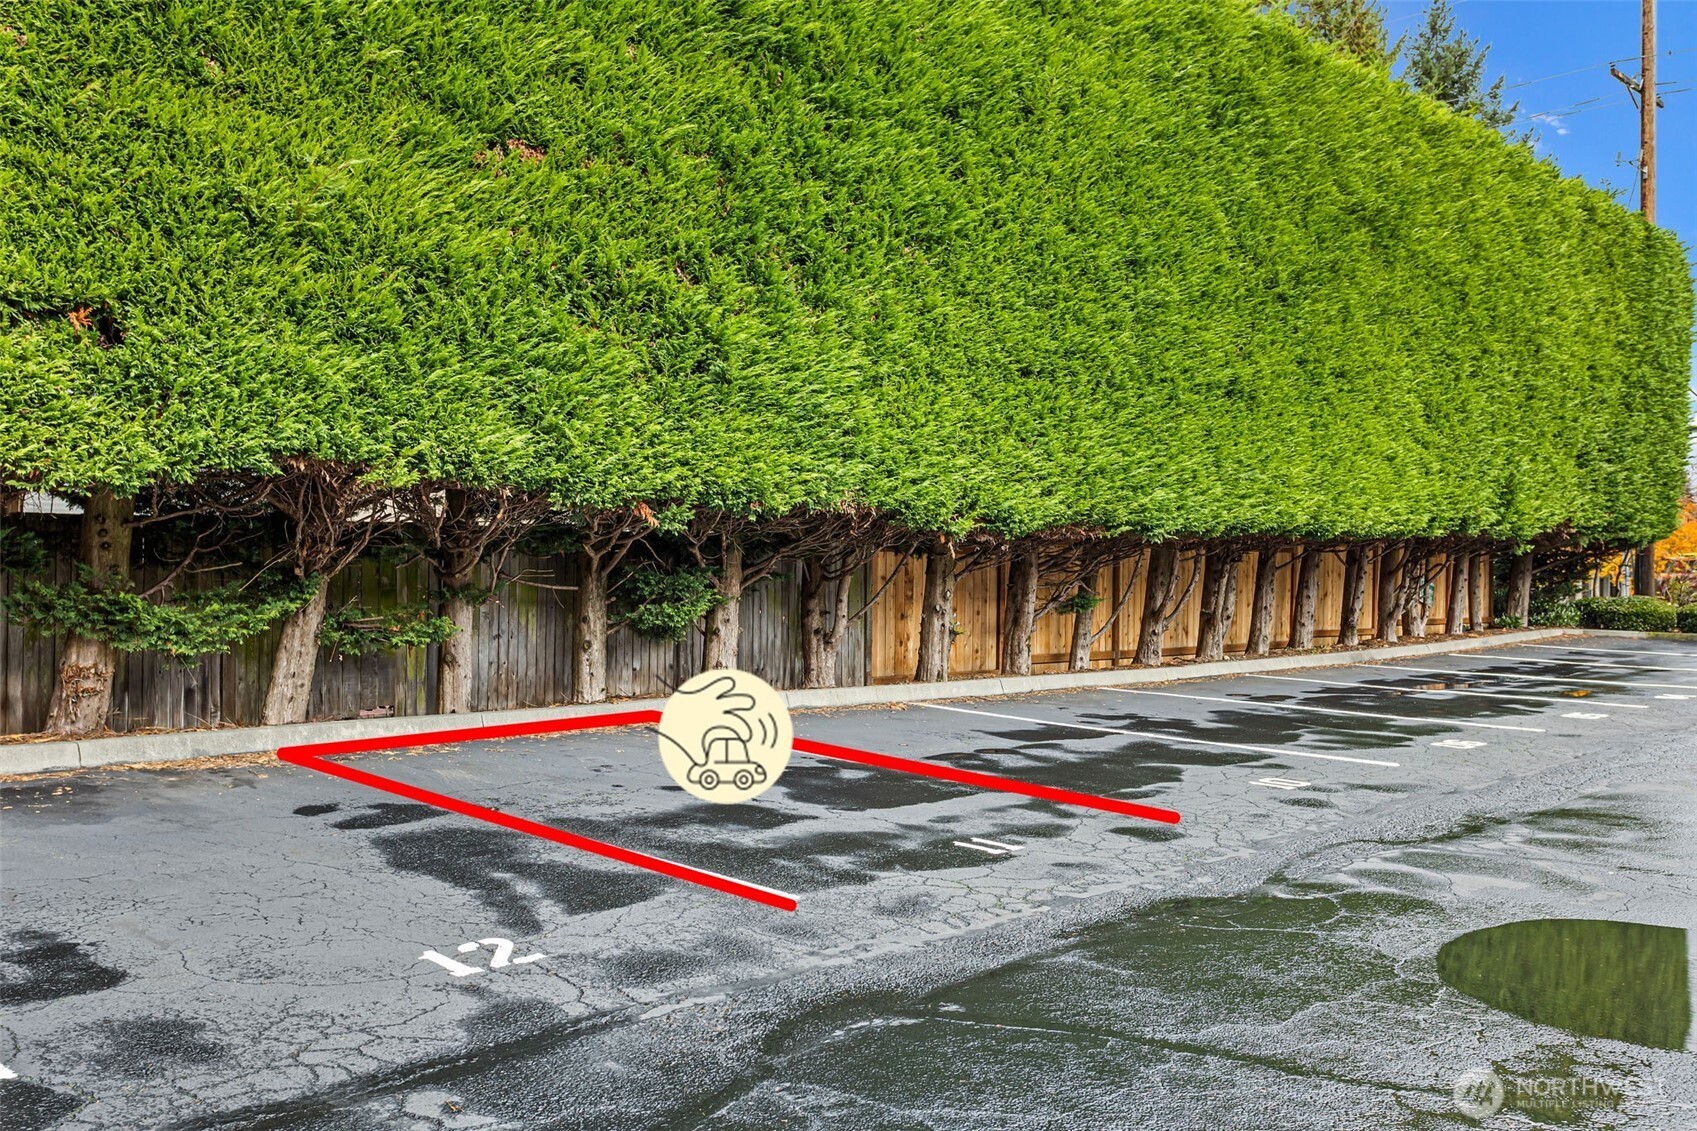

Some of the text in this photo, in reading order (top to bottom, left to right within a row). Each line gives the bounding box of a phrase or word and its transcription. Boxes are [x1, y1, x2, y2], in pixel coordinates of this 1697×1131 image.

[1249, 777, 1312, 791] 10
[953, 837, 1026, 855] 11
[418, 937, 547, 977] 12
